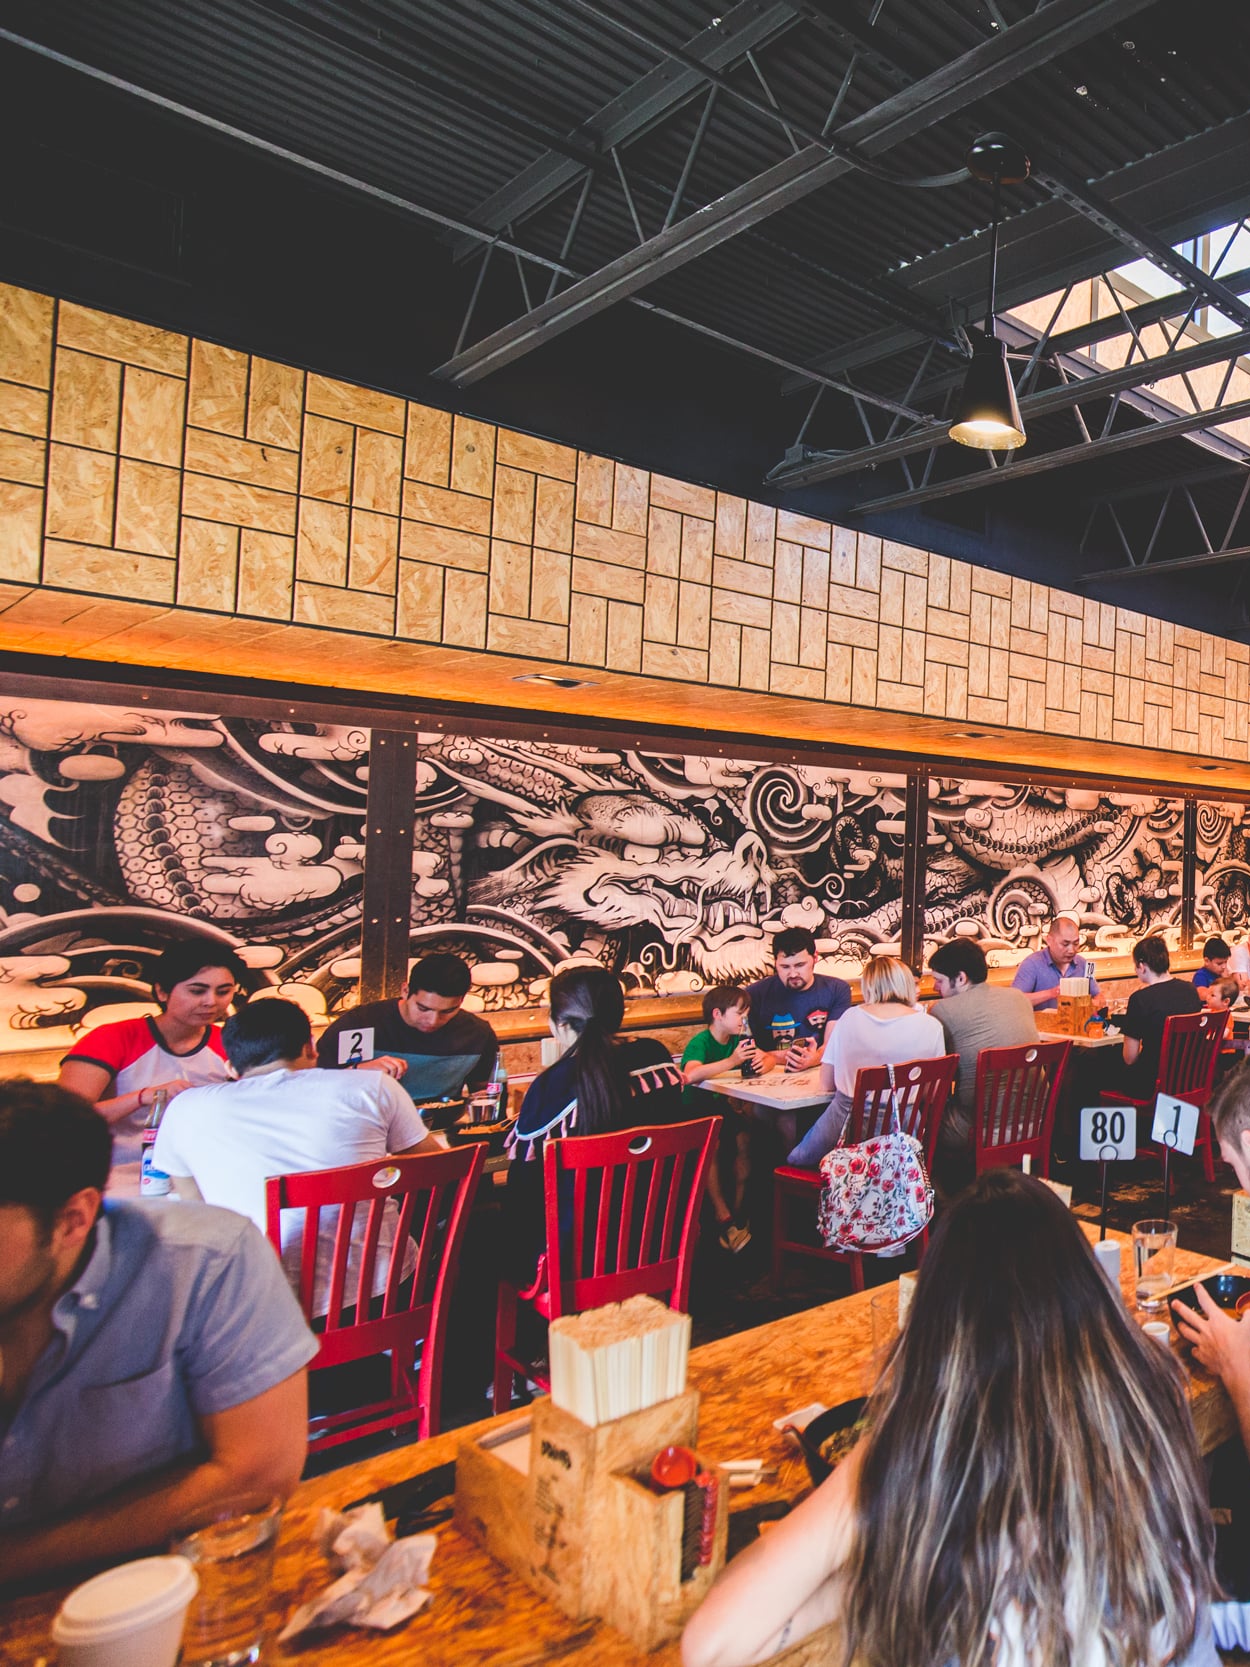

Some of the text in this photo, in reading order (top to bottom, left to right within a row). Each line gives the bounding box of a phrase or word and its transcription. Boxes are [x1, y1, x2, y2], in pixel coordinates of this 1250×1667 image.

[350, 1032, 363, 1054] 2
[1091, 1111, 1125, 1144] 80
[1173, 1105, 1181, 1136] 1
